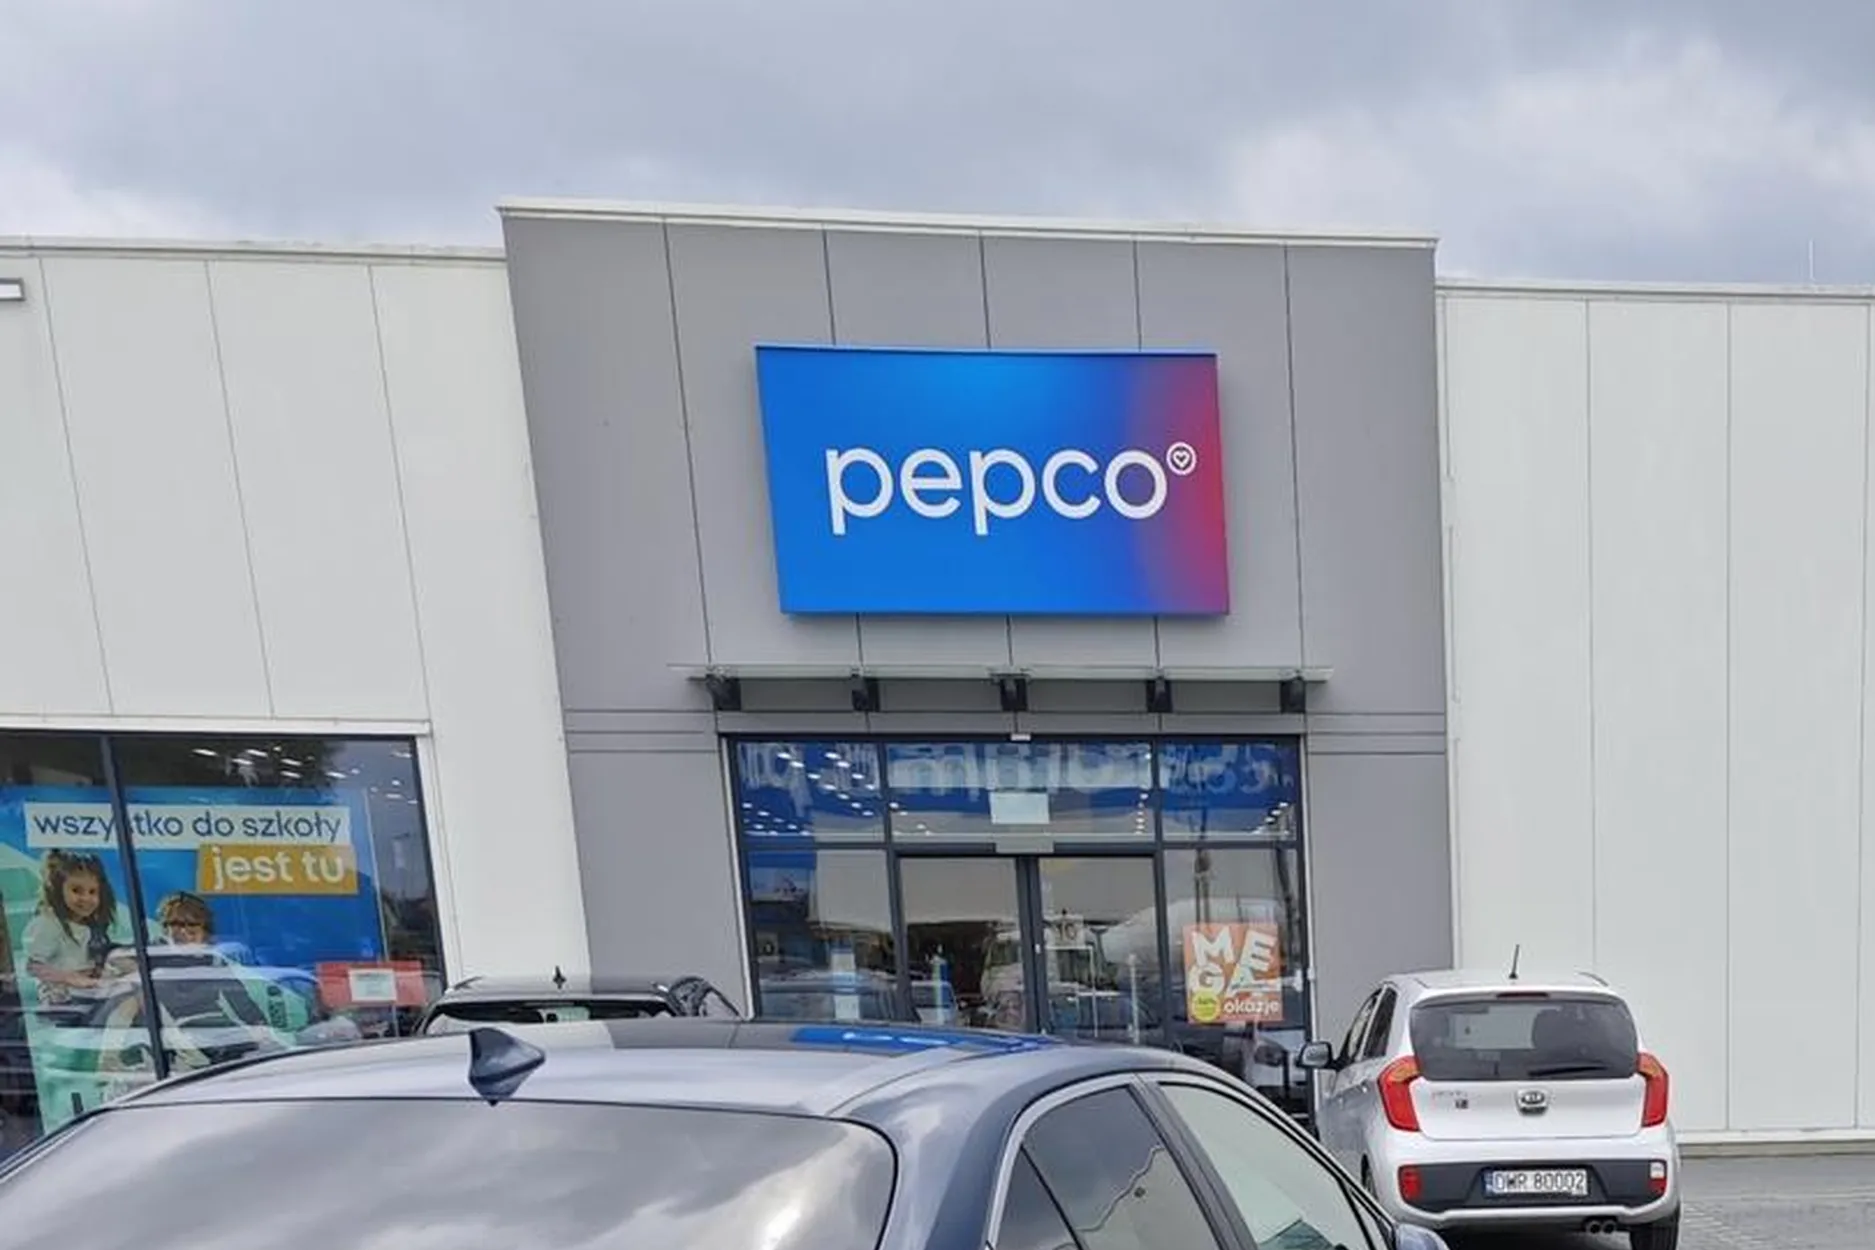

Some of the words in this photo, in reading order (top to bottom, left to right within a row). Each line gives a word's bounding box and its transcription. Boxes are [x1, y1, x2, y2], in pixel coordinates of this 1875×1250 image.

[826, 446, 1168, 536] pepco
[33, 809, 184, 842] wszytko
[192, 809, 235, 838] do
[241, 809, 341, 843] szkoły
[211, 845, 295, 891] jest
[302, 851, 345, 883] tu
[1223, 998, 1281, 1015] okazje
